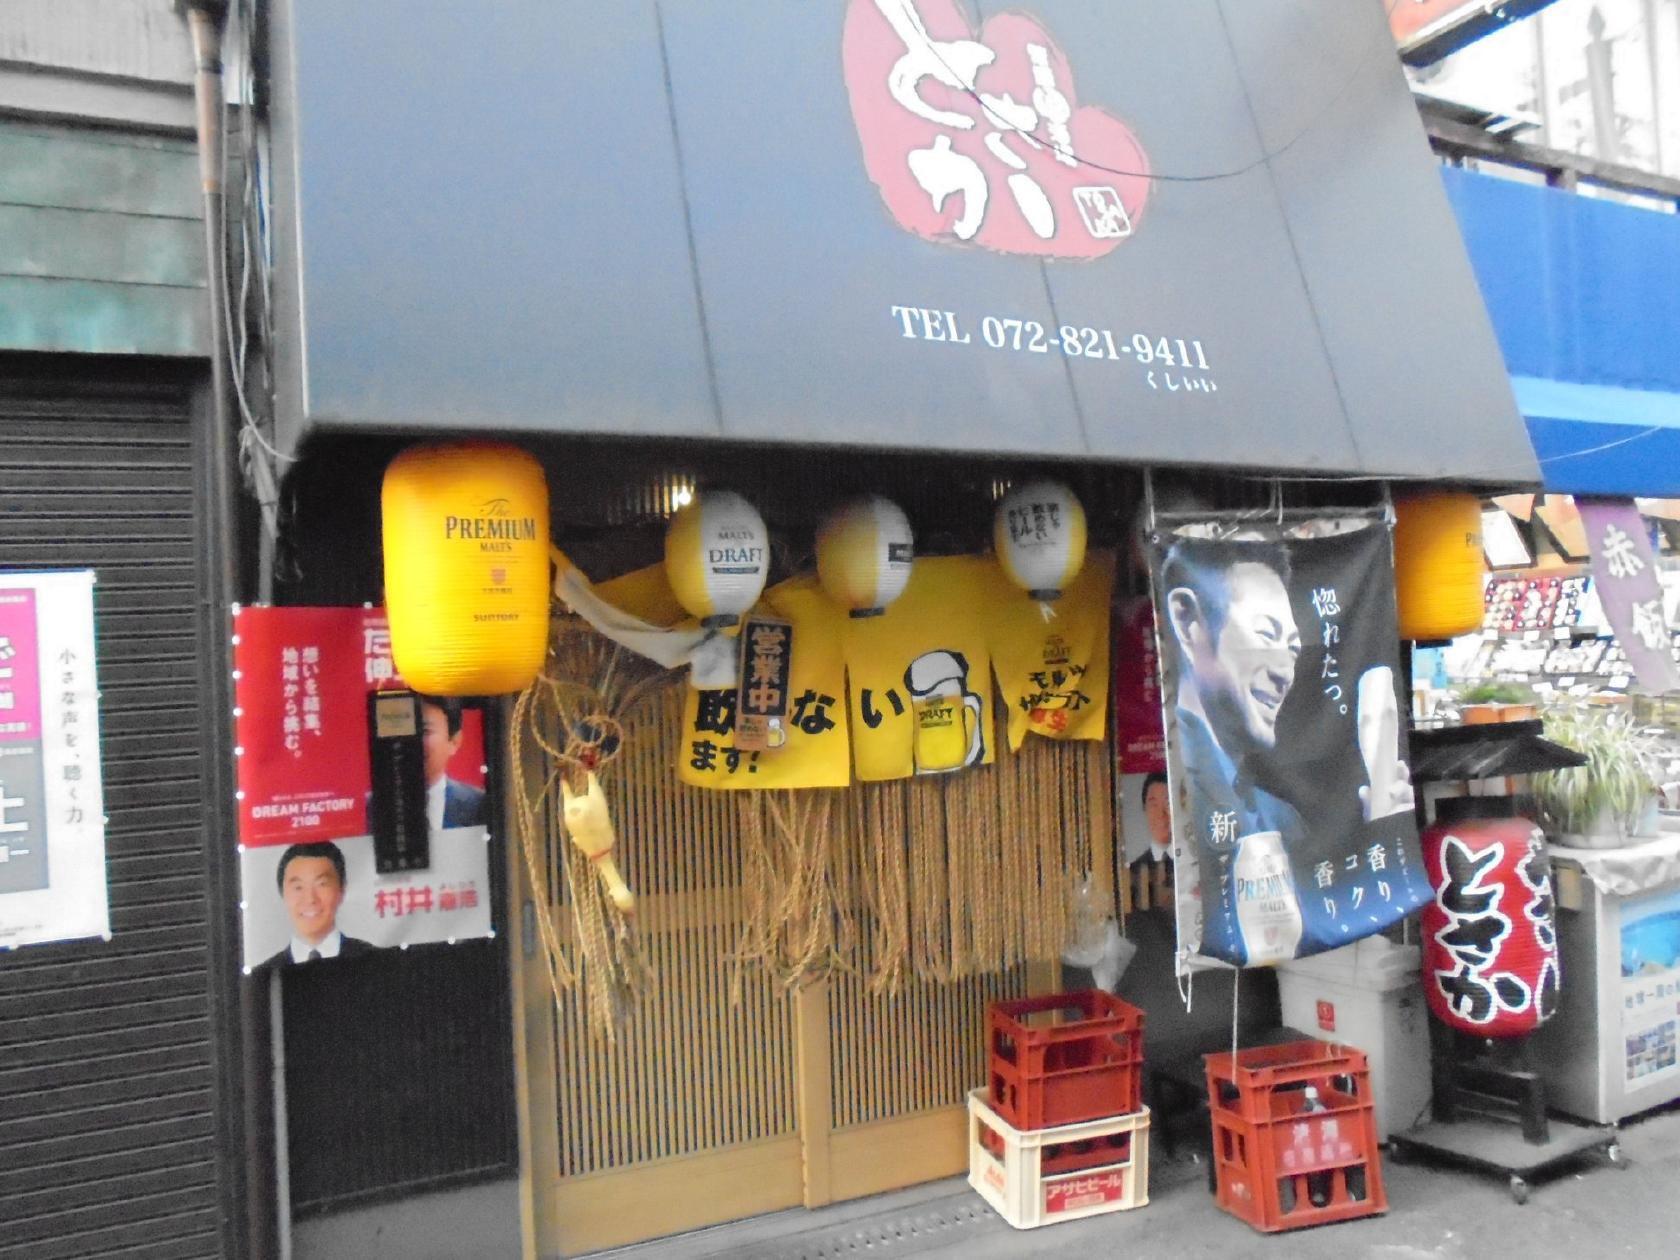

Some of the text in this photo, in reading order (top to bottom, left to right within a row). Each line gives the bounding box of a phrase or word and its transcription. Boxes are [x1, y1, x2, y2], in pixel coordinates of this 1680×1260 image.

[892, 305, 1210, 370] TEL 072-821-9411
[1147, 371, 1217, 393] くしいい
[446, 516, 536, 540] PREMIUM
[709, 547, 762, 562] DRAFT
[751, 626, 786, 713] 営業中
[252, 798, 355, 819] DREAM FACTORY
[1209, 810, 1238, 844] 新
[374, 885, 433, 918] 村井
[1048, 1173, 1122, 1199] アサヒビール
